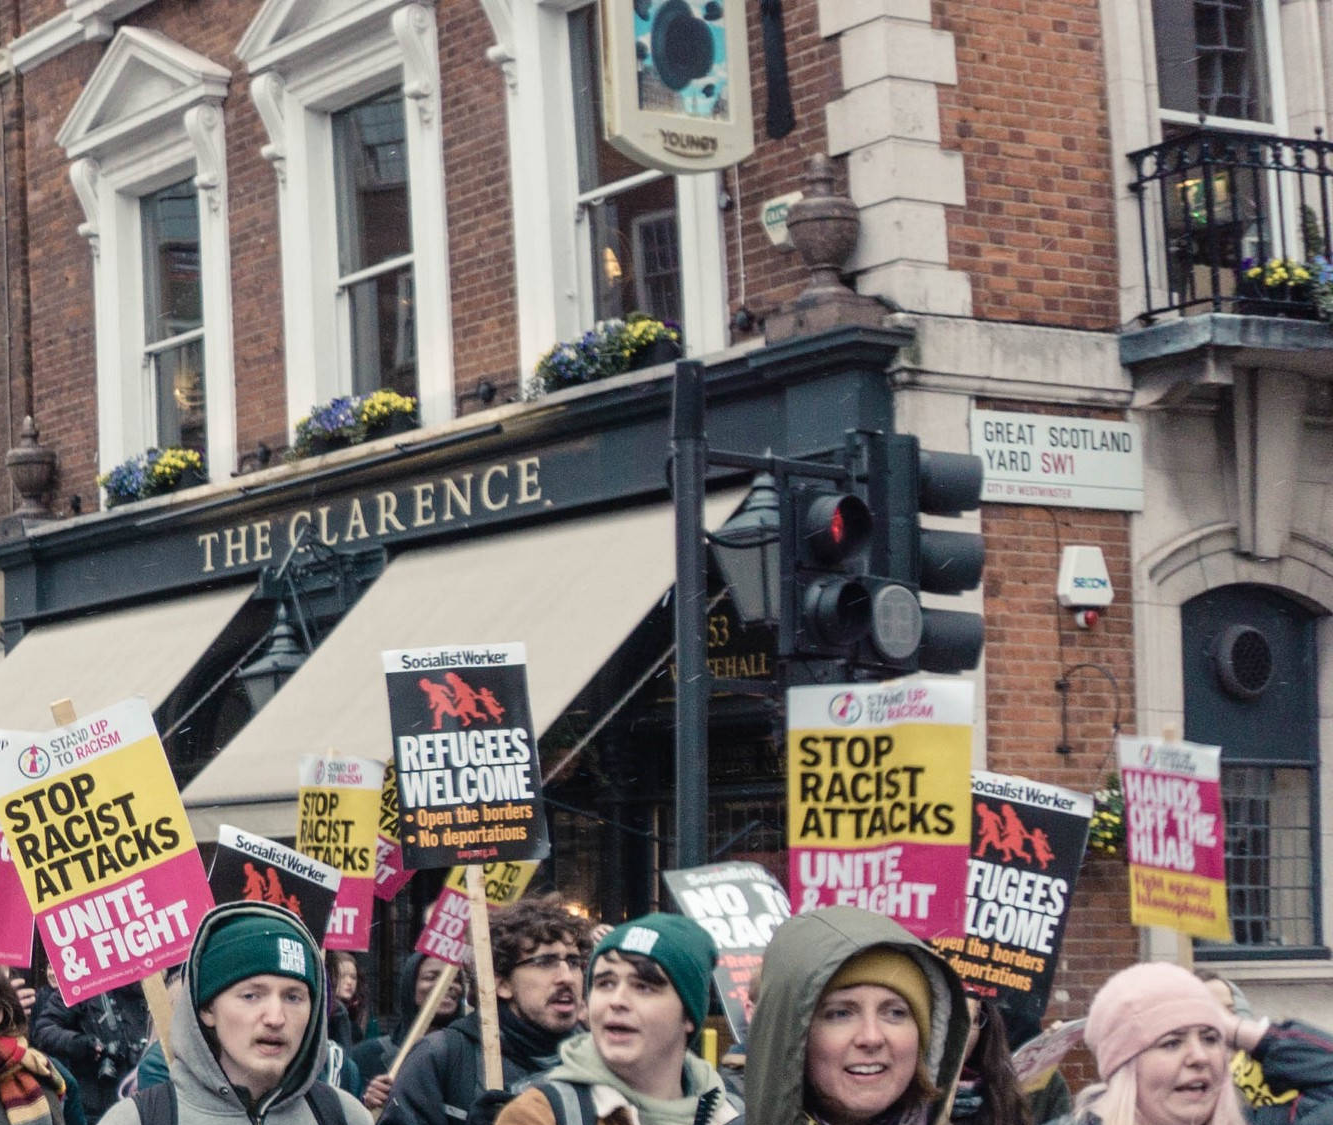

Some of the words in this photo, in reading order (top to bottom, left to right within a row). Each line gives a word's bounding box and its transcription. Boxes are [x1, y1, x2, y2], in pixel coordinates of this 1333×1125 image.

[984, 421, 1035, 446] GREAT
[1048, 426, 1132, 453] SCOTLAND
[985, 449, 1031, 472] YARD
[1041, 452, 1076, 475] SW1
[198, 519, 272, 573] THE
[288, 457, 544, 550] CLARENCE
[709, 614, 730, 648] 53
[907, 688, 927, 701] UP
[49, 728, 89, 752] STAND
[89, 719, 109, 736] UP
[54, 751, 75, 768] TO
[75, 731, 122, 761] RACISM
[398, 727, 531, 772] REFUGEES
[799, 735, 894, 768] STOP
[4, 772, 96, 834] STOP
[401, 764, 535, 809] WELCOME
[800, 765, 925, 804] RACIST
[1124, 770, 1202, 813] HANDS
[301, 792, 339, 817] STOP
[417, 807, 453, 831] Open
[457, 804, 480, 825] the
[483, 802, 533, 823] borders
[799, 801, 956, 840] ATTACKS
[15, 792, 136, 870] RACIST
[300, 818, 355, 844] RACIST
[419, 829, 440, 848] No
[442, 825, 528, 849] deportations
[1129, 803, 1168, 833] OFF
[1172, 808, 1218, 848] THE
[34, 816, 180, 904] ATTACKS
[799, 846, 904, 888] UNITE
[1132, 832, 1196, 872] HIJAB
[44, 878, 154, 948] UNITE
[442, 893, 471, 920] NO
[682, 883, 749, 918] NO
[836, 883, 937, 920] FIGHT
[60, 945, 91, 983] &
[90, 898, 192, 970] FIGHT
[435, 913, 464, 938] TO
[968, 937, 989, 958] the
[992, 943, 1046, 974] borders
